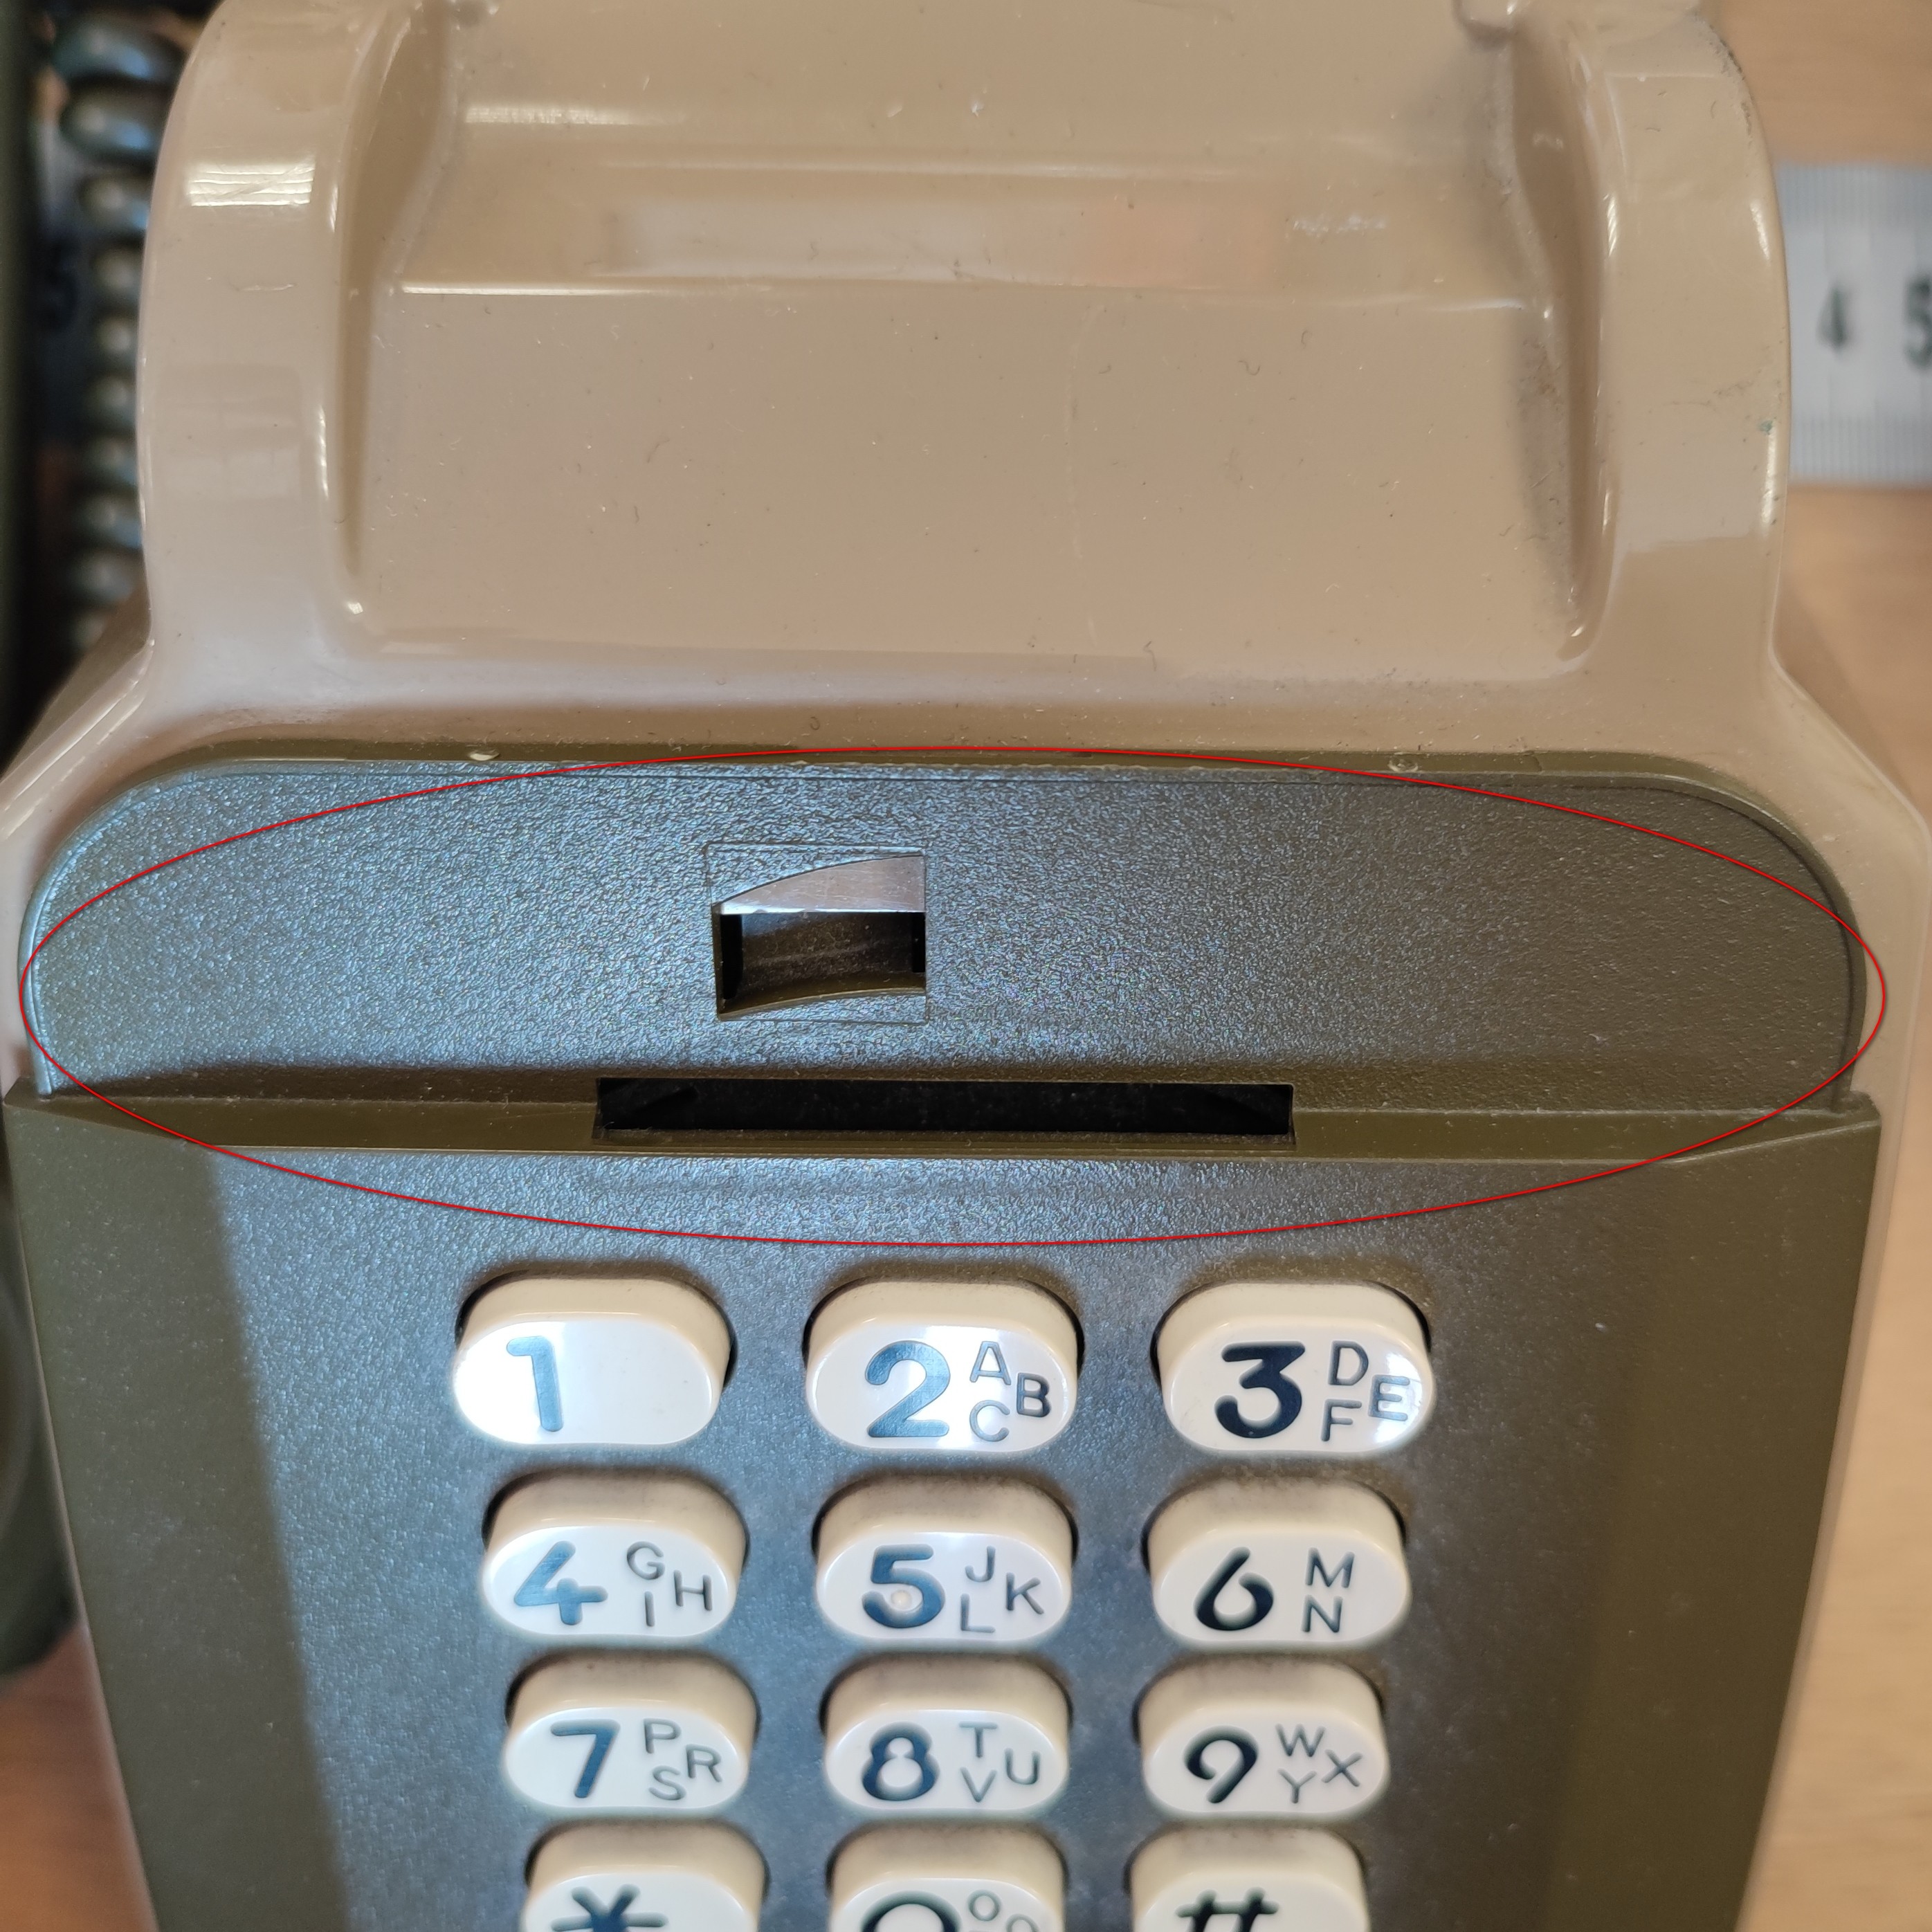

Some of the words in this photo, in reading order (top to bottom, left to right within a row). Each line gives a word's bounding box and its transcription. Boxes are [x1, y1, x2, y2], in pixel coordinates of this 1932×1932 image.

[970, 1341, 1012, 1385] A
[1328, 1340, 1369, 1386] D
[507, 1336, 564, 1432] 1
[865, 1340, 951, 1437] 2
[1017, 1372, 1052, 1417] B
[1214, 1340, 1306, 1439] 3
[1368, 1375, 1410, 1421] E
[969, 1400, 1010, 1441] C
[1321, 1398, 1362, 1441] F
[627, 1541, 666, 1580] G
[965, 1546, 996, 1582] J
[1305, 1547, 1355, 1588] M
[514, 1540, 608, 1625] 4
[674, 1569, 713, 1611] H
[862, 1544, 945, 1628] 5
[1005, 1573, 1044, 1615] K
[1194, 1547, 1274, 1631] 6
[644, 1591, 655, 1627] I
[960, 1594, 995, 1634] L
[1301, 1595, 1343, 1633] N
[644, 1718, 682, 1753] P
[959, 1721, 997, 1758] T
[1275, 1723, 1326, 1758] W
[551, 1719, 621, 1798] 7
[686, 1744, 722, 1783] R
[862, 1721, 940, 1801] 8
[1005, 1748, 1040, 1785] U
[1183, 1724, 1259, 1804] 9
[1321, 1749, 1363, 1787] X
[648, 1765, 686, 1801] S
[960, 1767, 997, 1803] V
[1277, 1767, 1316, 1803] Y
